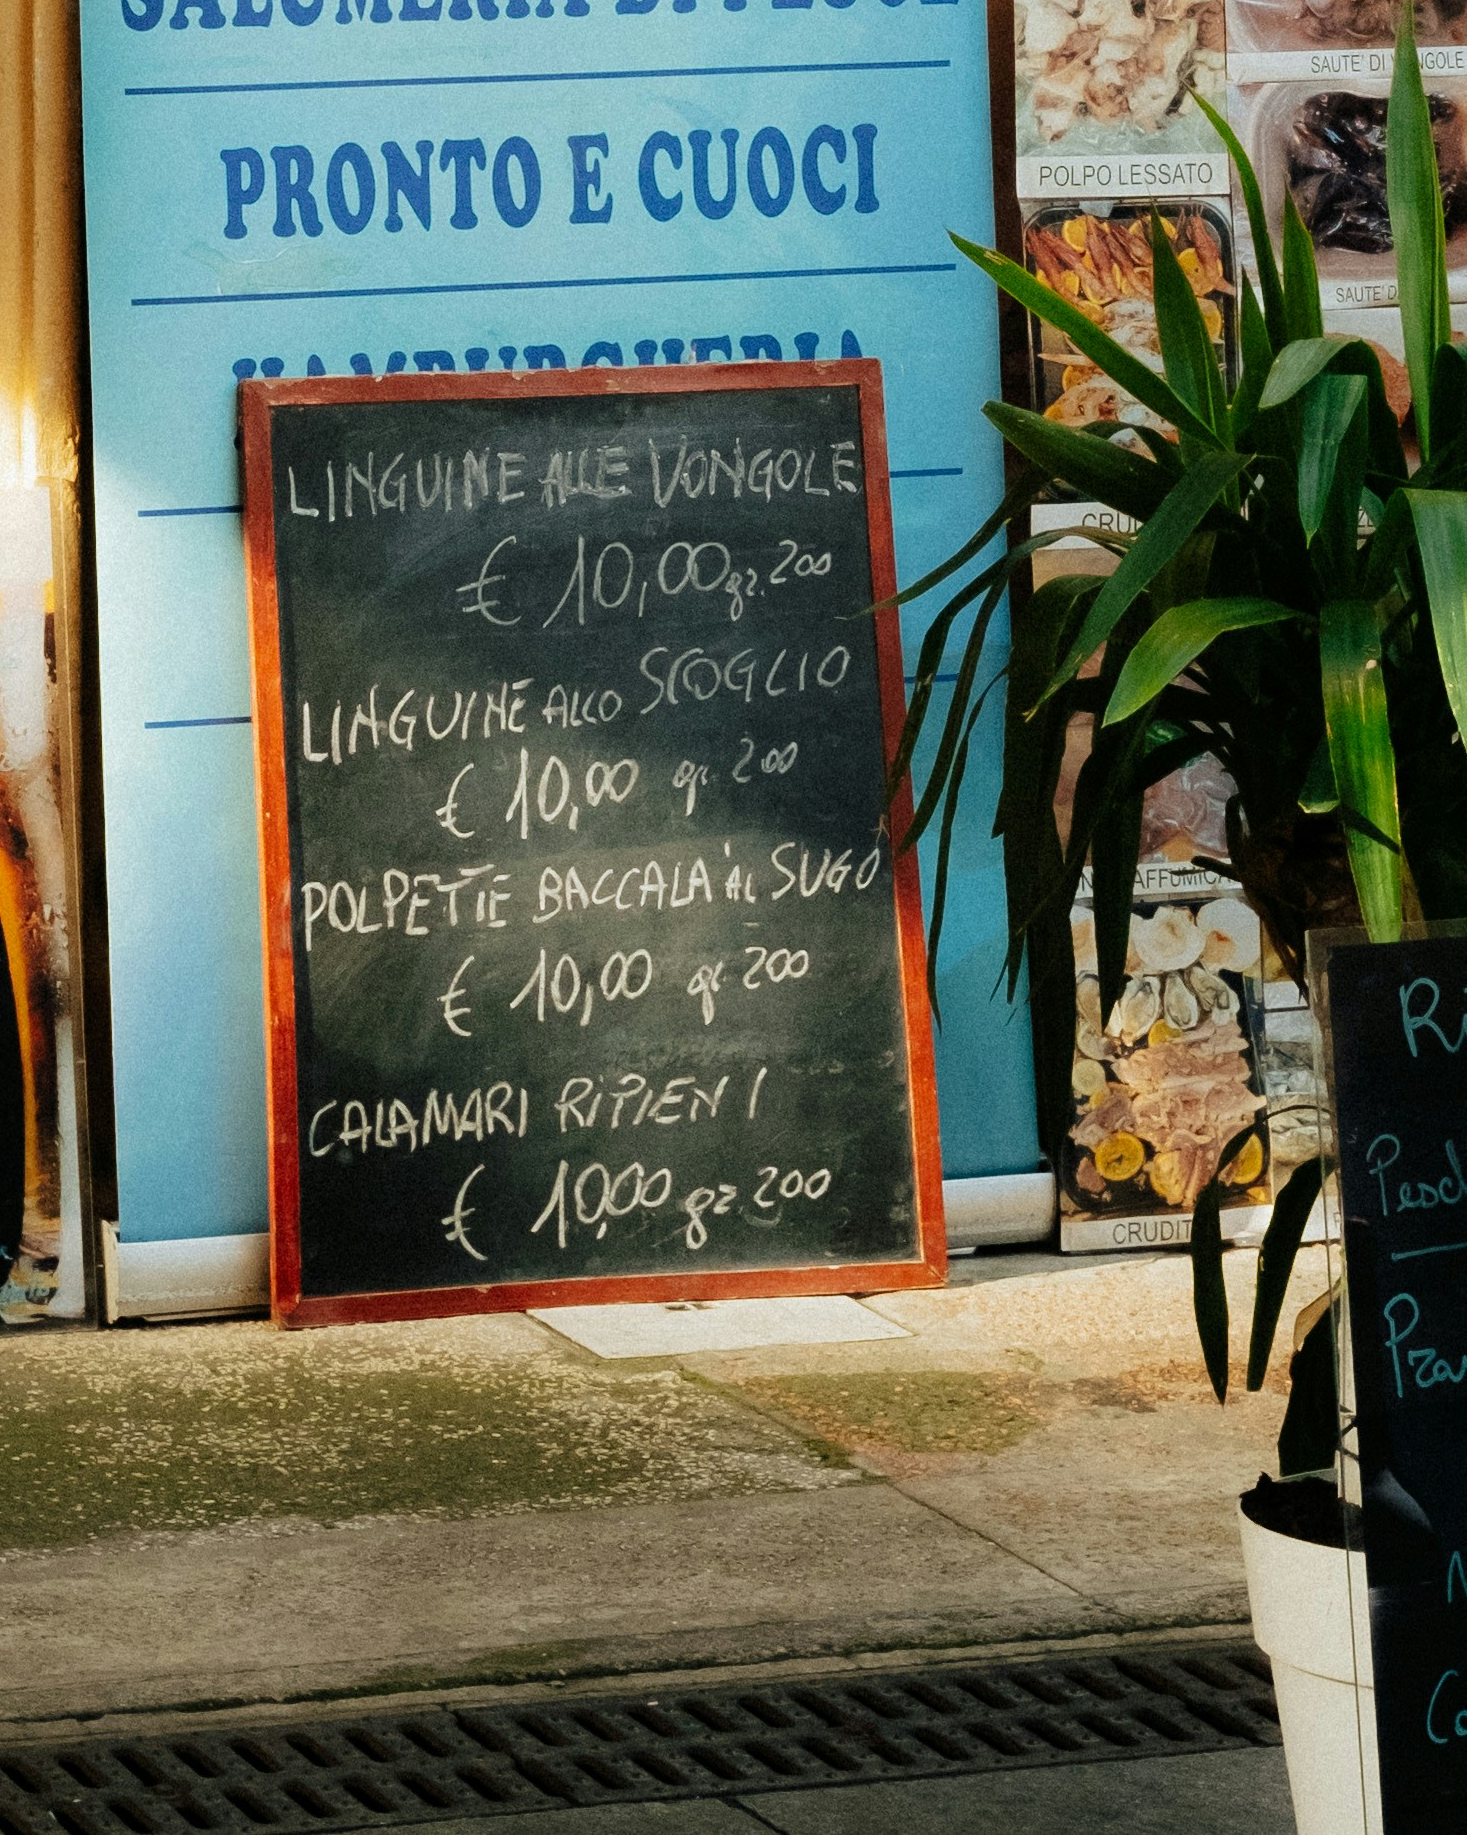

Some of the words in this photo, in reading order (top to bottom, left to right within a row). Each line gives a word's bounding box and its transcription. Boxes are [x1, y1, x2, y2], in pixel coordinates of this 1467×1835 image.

[1311, 55, 1364, 73] SAUTE'
[1370, 54, 1384, 71] DI
[1391, 51, 1464, 69] GOLE
[219, 133, 542, 240] PRONTO
[569, 133, 614, 226] E
[637, 122, 880, 222] CUOCI
[1038, 163, 1112, 188] POLPO
[1118, 161, 1213, 186] LESSATO
[288, 451, 526, 521] LINGUINE
[538, 446, 630, 510] ALLE
[648, 433, 863, 507] VONGOLE
[1082, 512, 1139, 535] CRU
[455, 536, 522, 626] €
[769, 540, 832, 584] 200
[302, 679, 533, 765] LINGUINE
[638, 645, 851, 716] SCOGLIO
[437, 762, 475, 839] €
[731, 738, 800, 783] 200
[771, 842, 882, 901] SUGO
[437, 955, 475, 1037] €
[741, 946, 810, 991] 200
[308, 1080, 530, 1157] CALAMARI
[442, 1163, 489, 1261] €
[754, 1166, 831, 1208] 200
